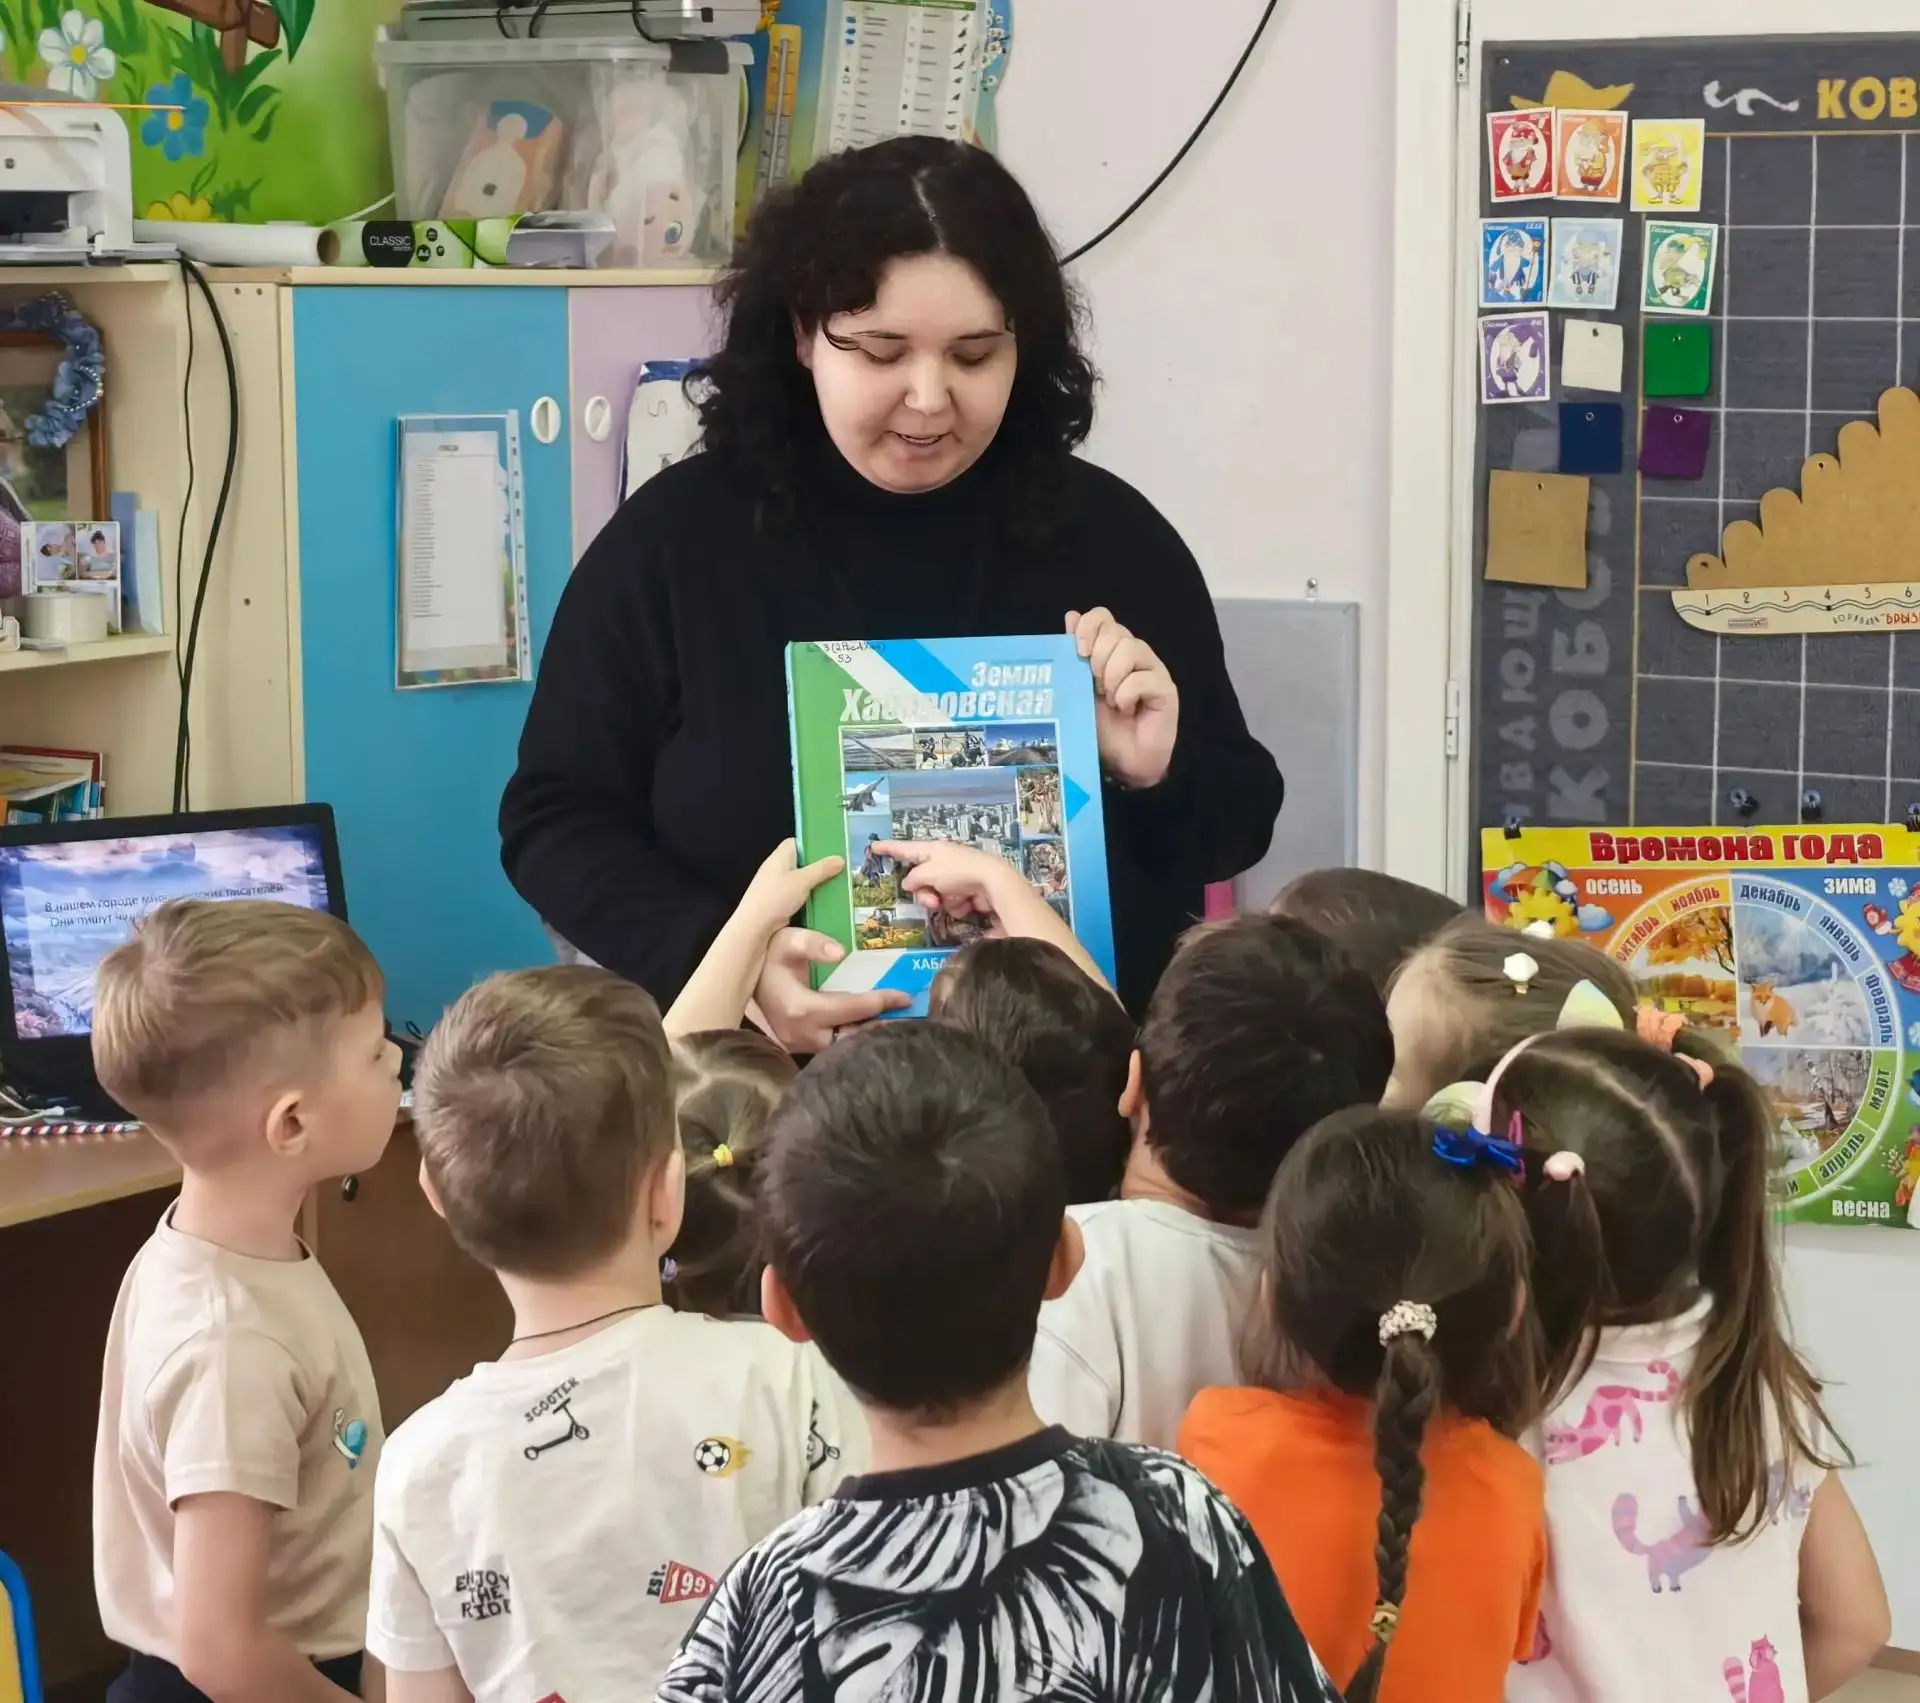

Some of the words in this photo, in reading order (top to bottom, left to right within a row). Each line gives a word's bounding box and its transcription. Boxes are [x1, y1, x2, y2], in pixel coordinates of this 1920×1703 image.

[369, 235, 411, 246] CLASSIC
[1824, 588, 1831, 600] 4
[1904, 585, 1912, 598] 6
[971, 661, 1053, 688] Земля
[1588, 831, 1775, 864] Времена
[1781, 833, 1883, 864] года
[1585, 877, 1644, 895] осень
[1669, 886, 1721, 912] ноябрь
[1739, 884, 1801, 912] декабрь
[1823, 877, 1877, 895] зима
[54, 900, 96, 913] нашем
[98, 896, 139, 909] городе
[50, 916, 74, 928] Они
[77, 913, 112, 925] пишут
[1615, 915, 1660, 962] октябрь
[1819, 914, 1861, 962] январь
[1865, 973, 1894, 1044] февраль
[1867, 1067, 1891, 1111] март
[1819, 1133, 1866, 1179] апрель
[1831, 1199, 1891, 1219] весна
[524, 1376, 580, 1423] SCOOTER
[455, 1569, 510, 1593] ENJOY
[469, 1584, 505, 1604] THE
